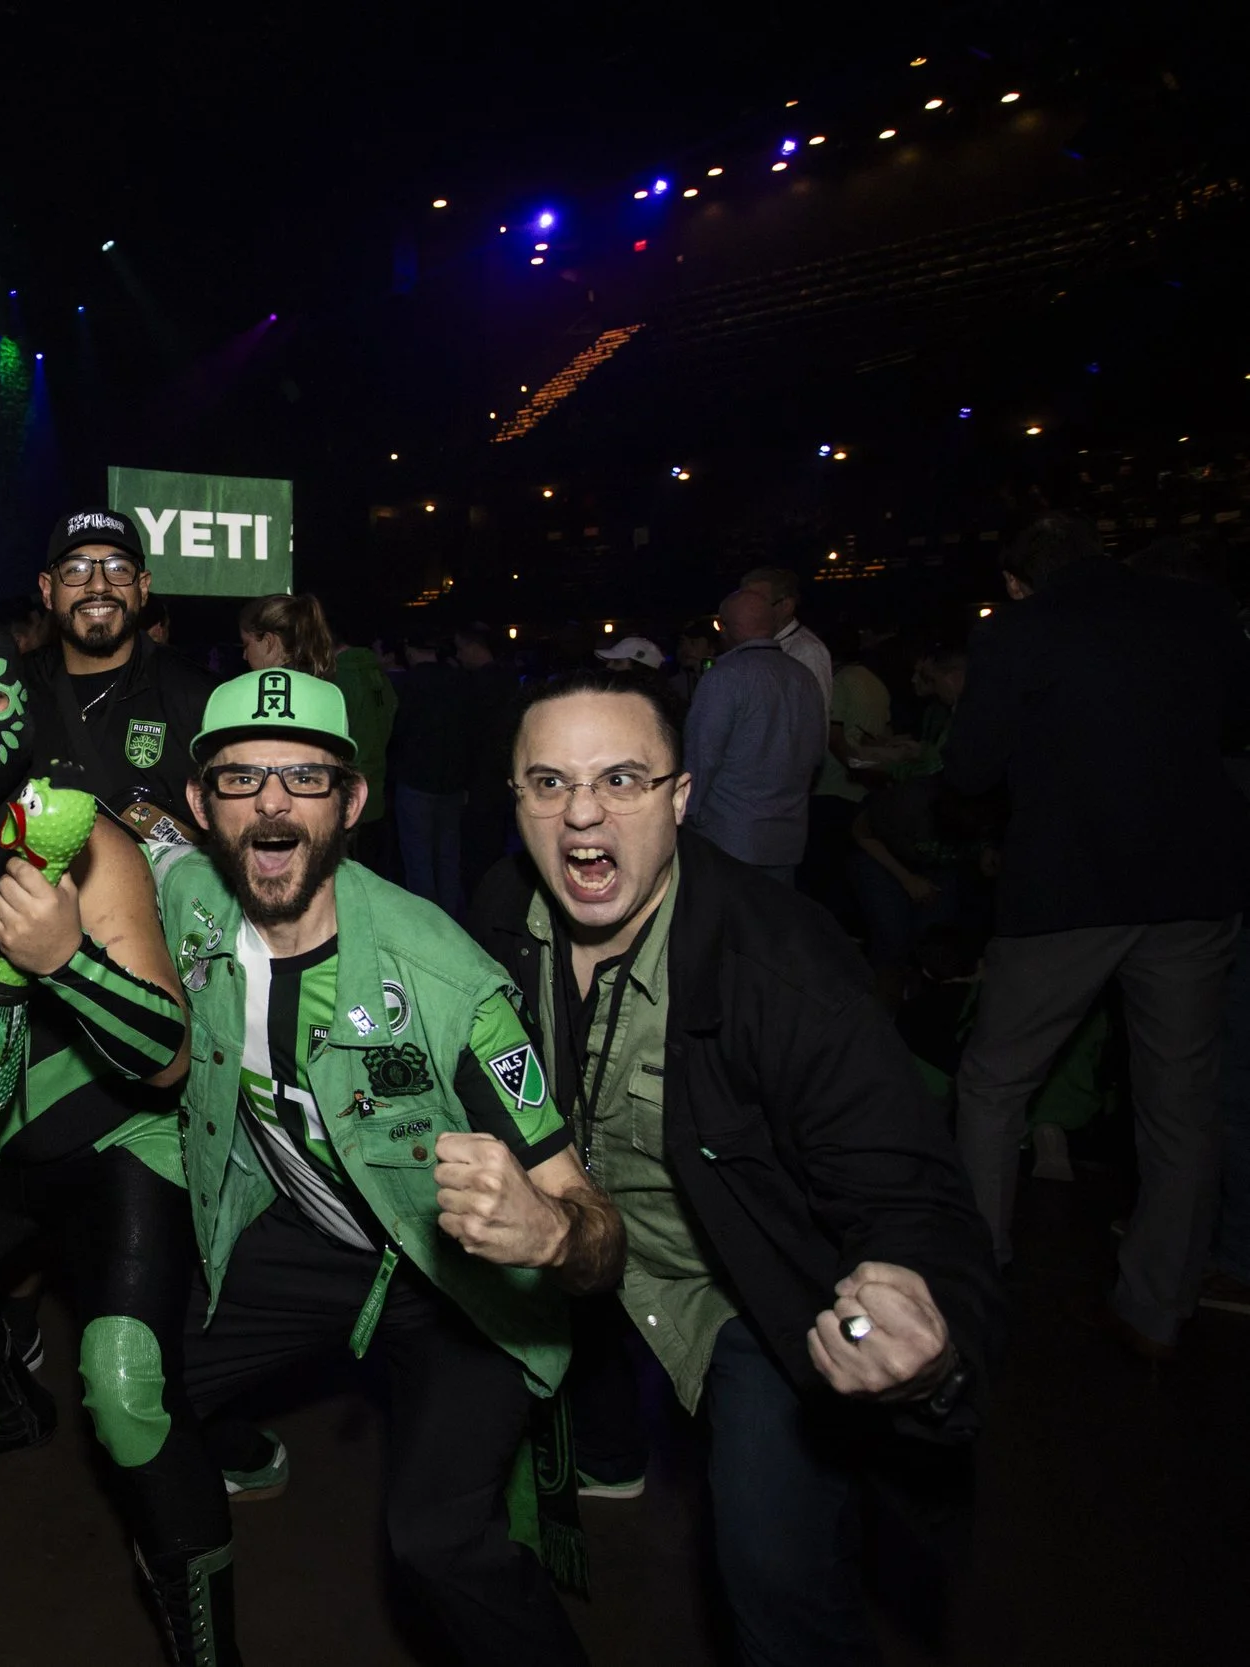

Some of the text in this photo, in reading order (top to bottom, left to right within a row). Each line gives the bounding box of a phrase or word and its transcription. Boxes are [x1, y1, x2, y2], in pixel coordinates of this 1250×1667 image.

[134, 507, 268, 560] YETI
[133, 724, 161, 734] AUSTIN
[495, 1054, 523, 1075] MLS
[362, 1103, 370, 1111] 6
